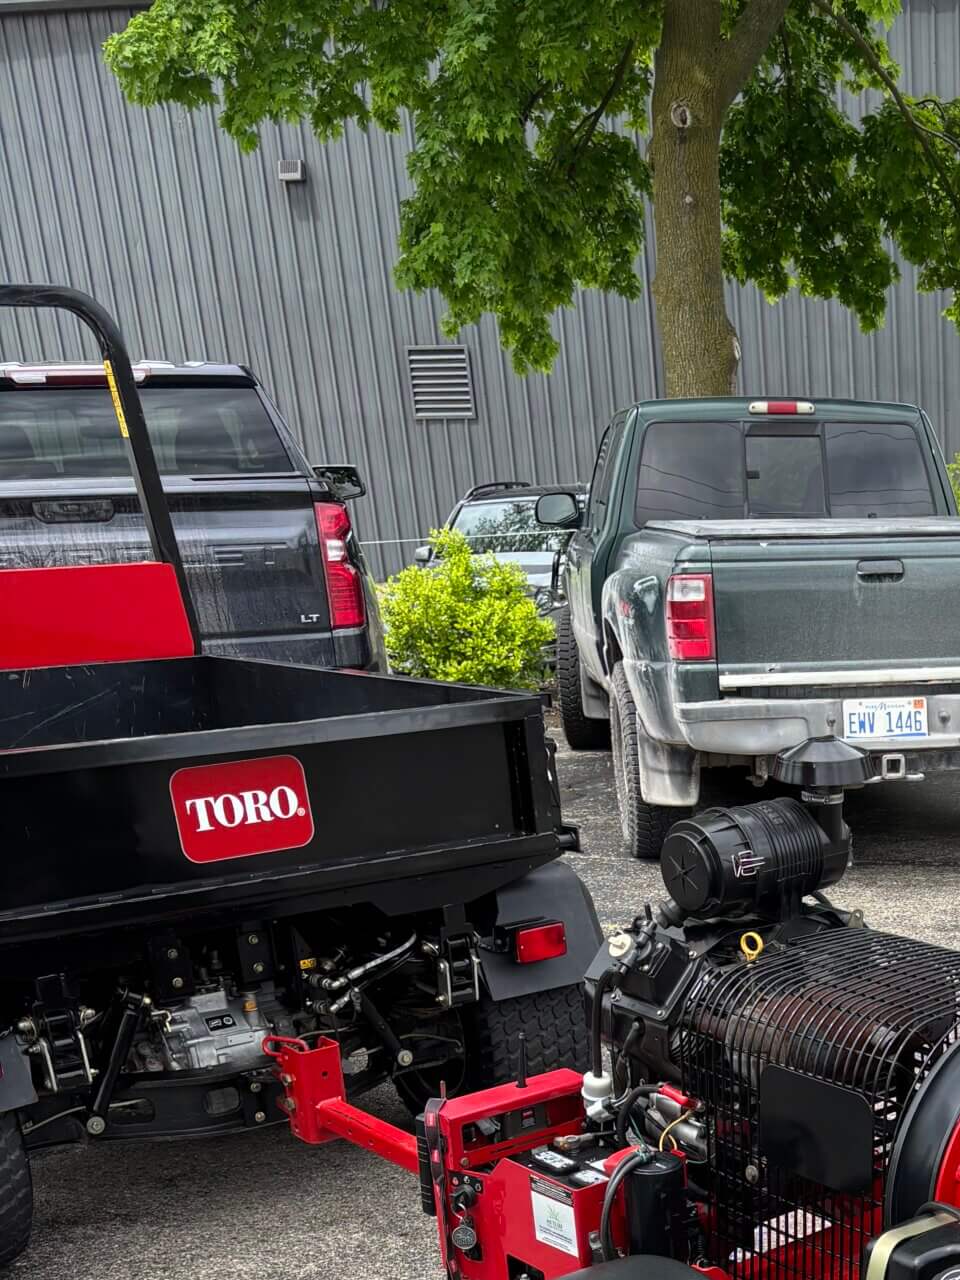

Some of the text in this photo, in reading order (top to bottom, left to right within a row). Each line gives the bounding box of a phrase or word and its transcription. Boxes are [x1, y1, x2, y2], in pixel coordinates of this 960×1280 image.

[301, 613, 321, 624] LT
[848, 710, 923, 735] EWV 1446
[185, 786, 299, 833] TORO
